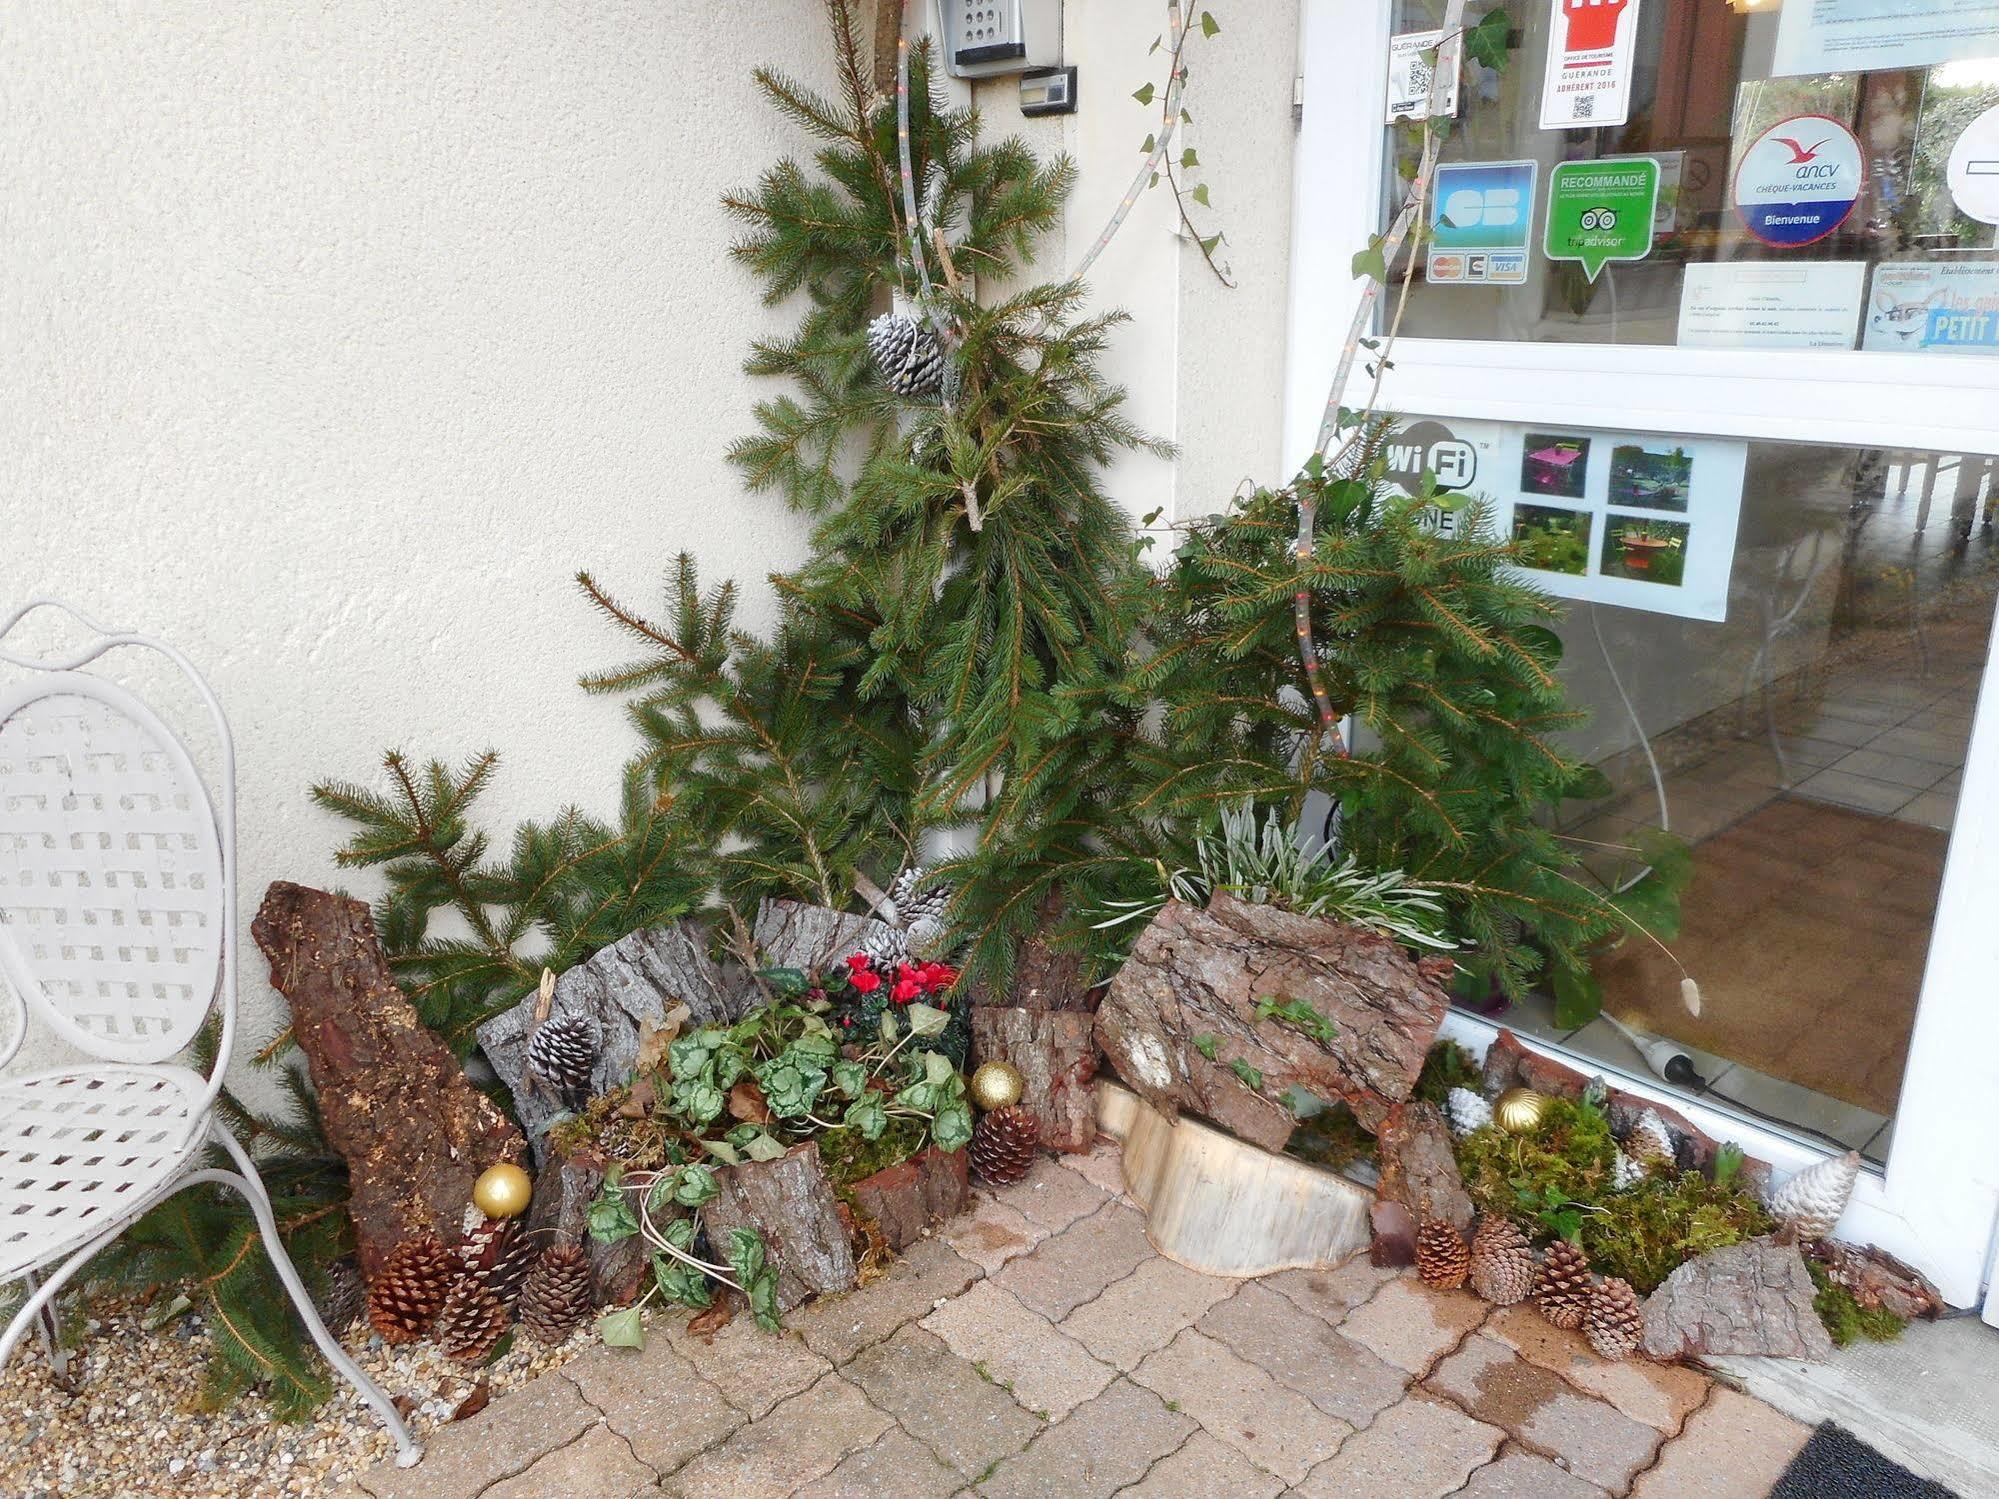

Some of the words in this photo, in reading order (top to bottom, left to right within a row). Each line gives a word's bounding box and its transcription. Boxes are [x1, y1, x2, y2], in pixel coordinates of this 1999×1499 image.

[1588, 52, 1614, 60] TOURISME
[1596, 80, 1616, 90] 2016
[1795, 164, 1840, 179] ancv
[1560, 172, 1647, 188] RECOMMANDÉ
[1765, 214, 1821, 226] Bienvenue
[1567, 235, 1623, 248] tripadvisor
[1494, 262, 1518, 272] VISA
[1933, 315, 1990, 341] PETIT
